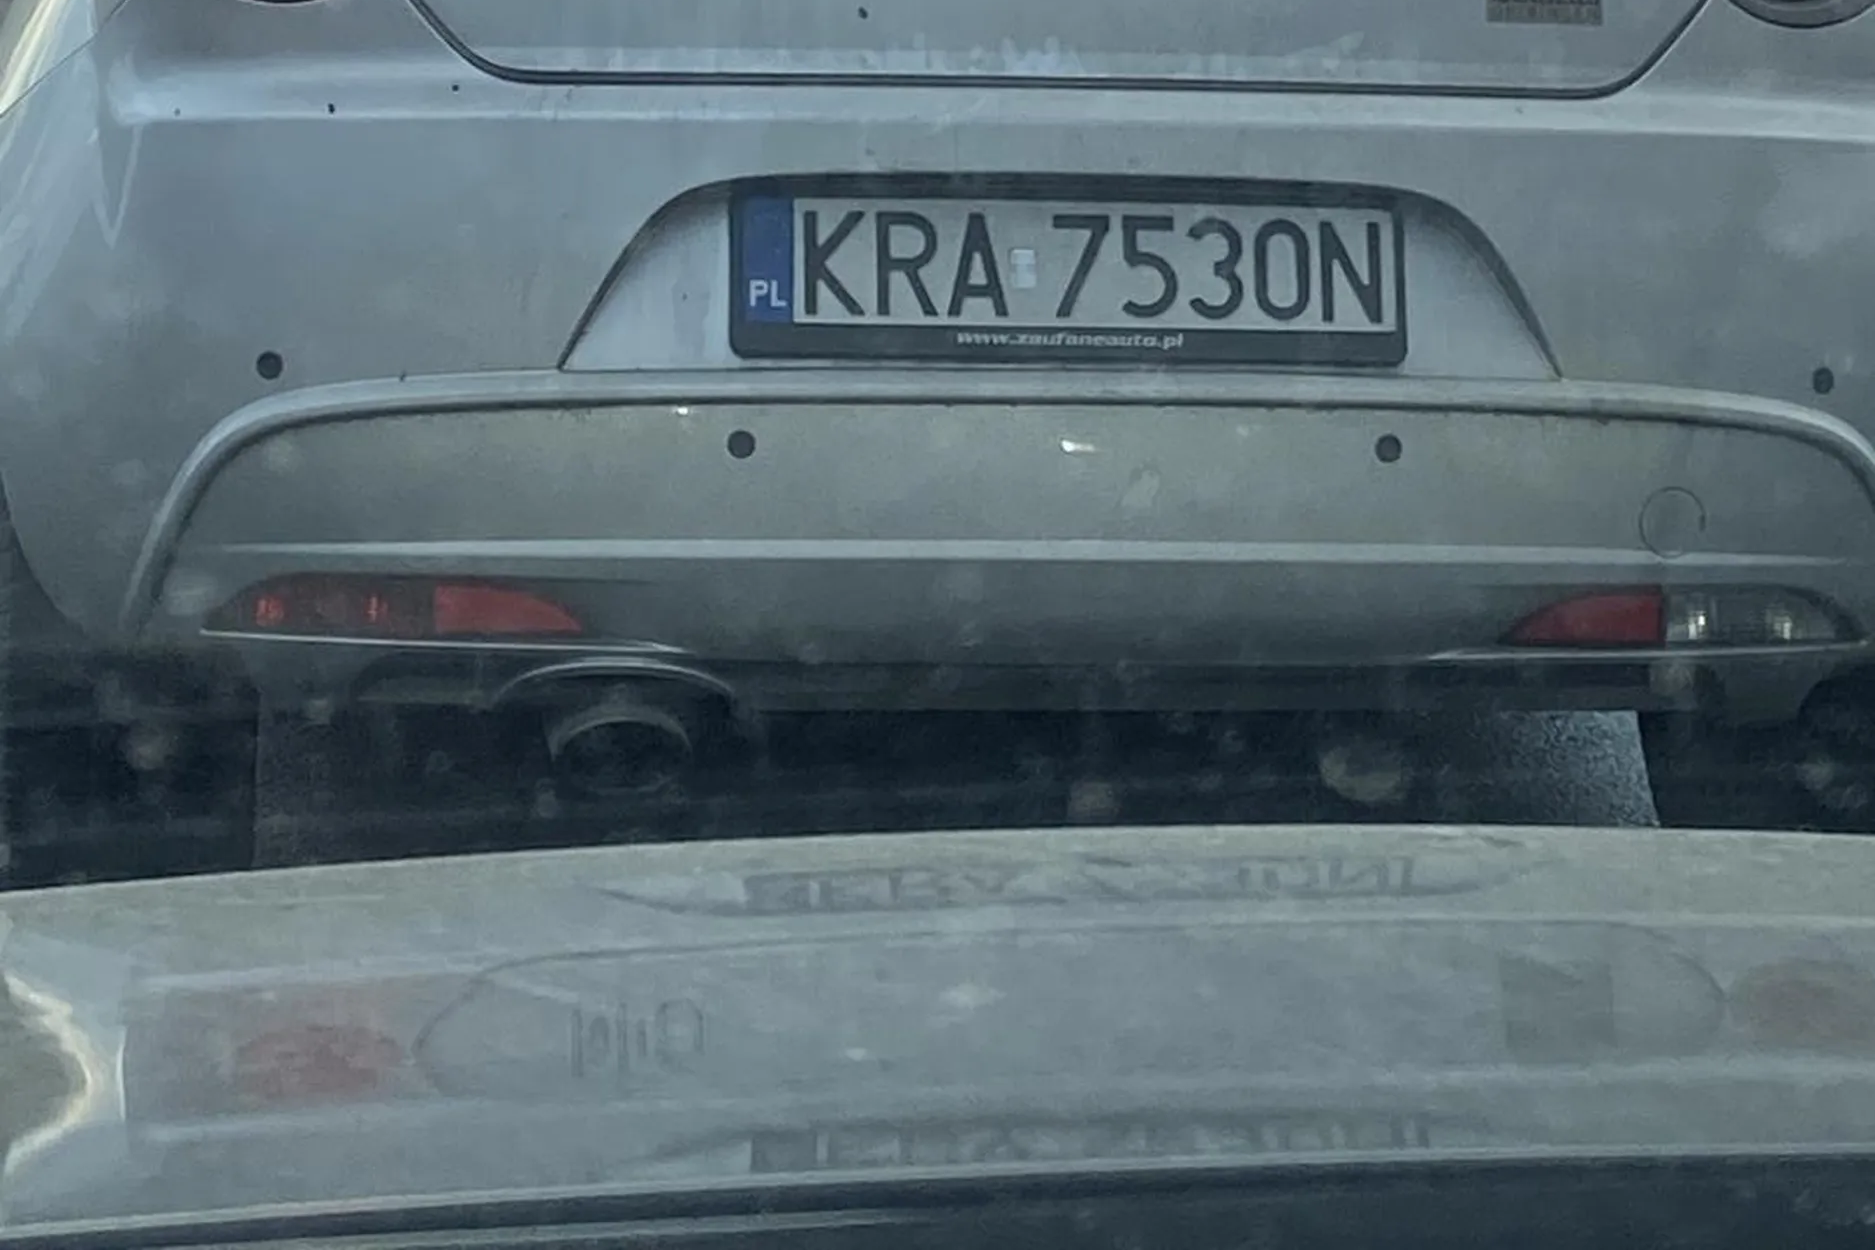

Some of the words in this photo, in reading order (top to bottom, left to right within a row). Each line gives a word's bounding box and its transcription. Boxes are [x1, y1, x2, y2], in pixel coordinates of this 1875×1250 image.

[803, 210, 1010, 318] KRA
[1052, 214, 1382, 324] 7530N
[749, 280, 787, 308] PL
[957, 330, 1184, 350] www.zaufaneauta.pl
